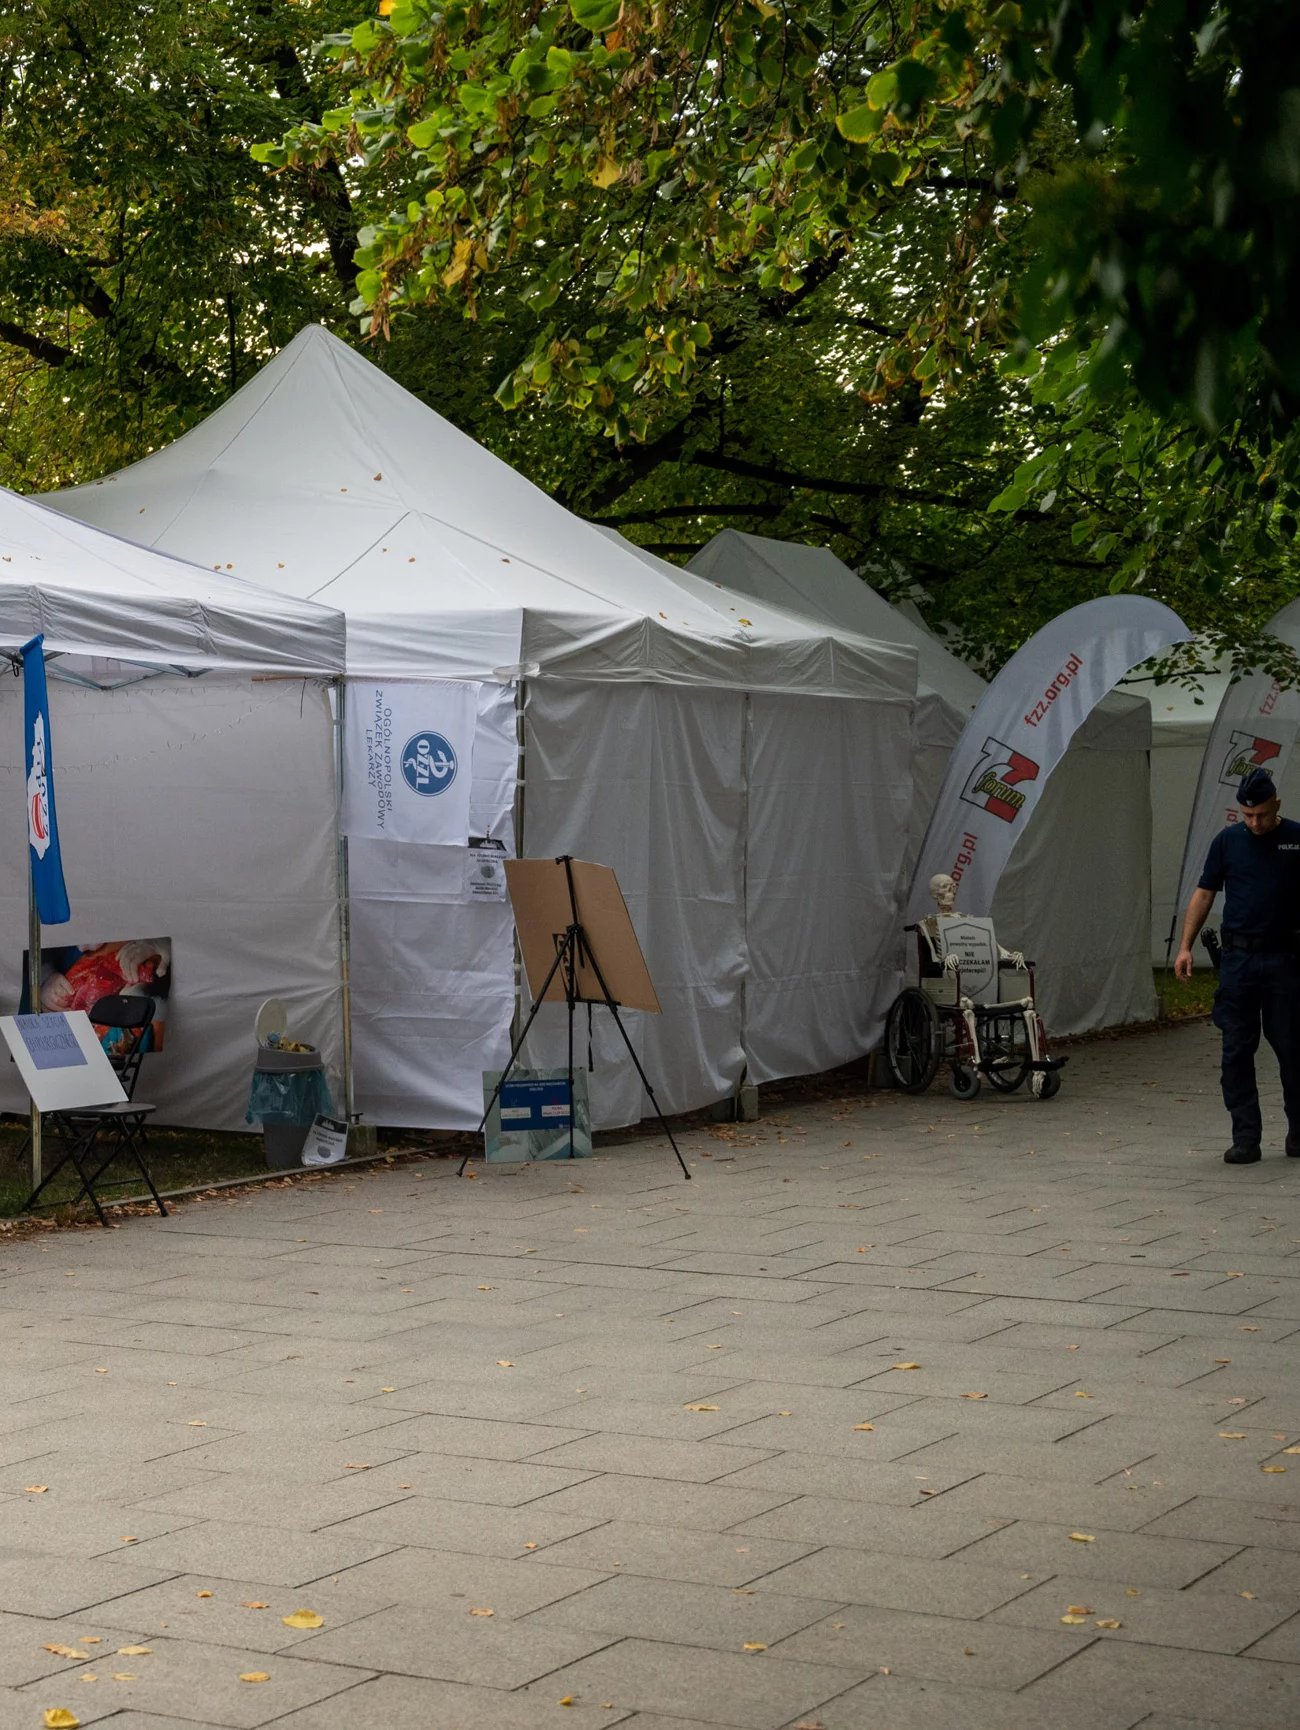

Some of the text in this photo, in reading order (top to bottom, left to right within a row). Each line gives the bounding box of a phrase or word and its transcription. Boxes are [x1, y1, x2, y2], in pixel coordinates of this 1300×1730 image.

[1024, 653, 1083, 727] fzz.org.pl
[365, 728, 377, 788] LEKARZY
[374, 752, 386, 829] ZAWODOWY
[383, 708, 393, 811] OGÓLNOPOLSKI
[415, 739, 430, 789] OZZL
[971, 771, 1027, 809] forum
